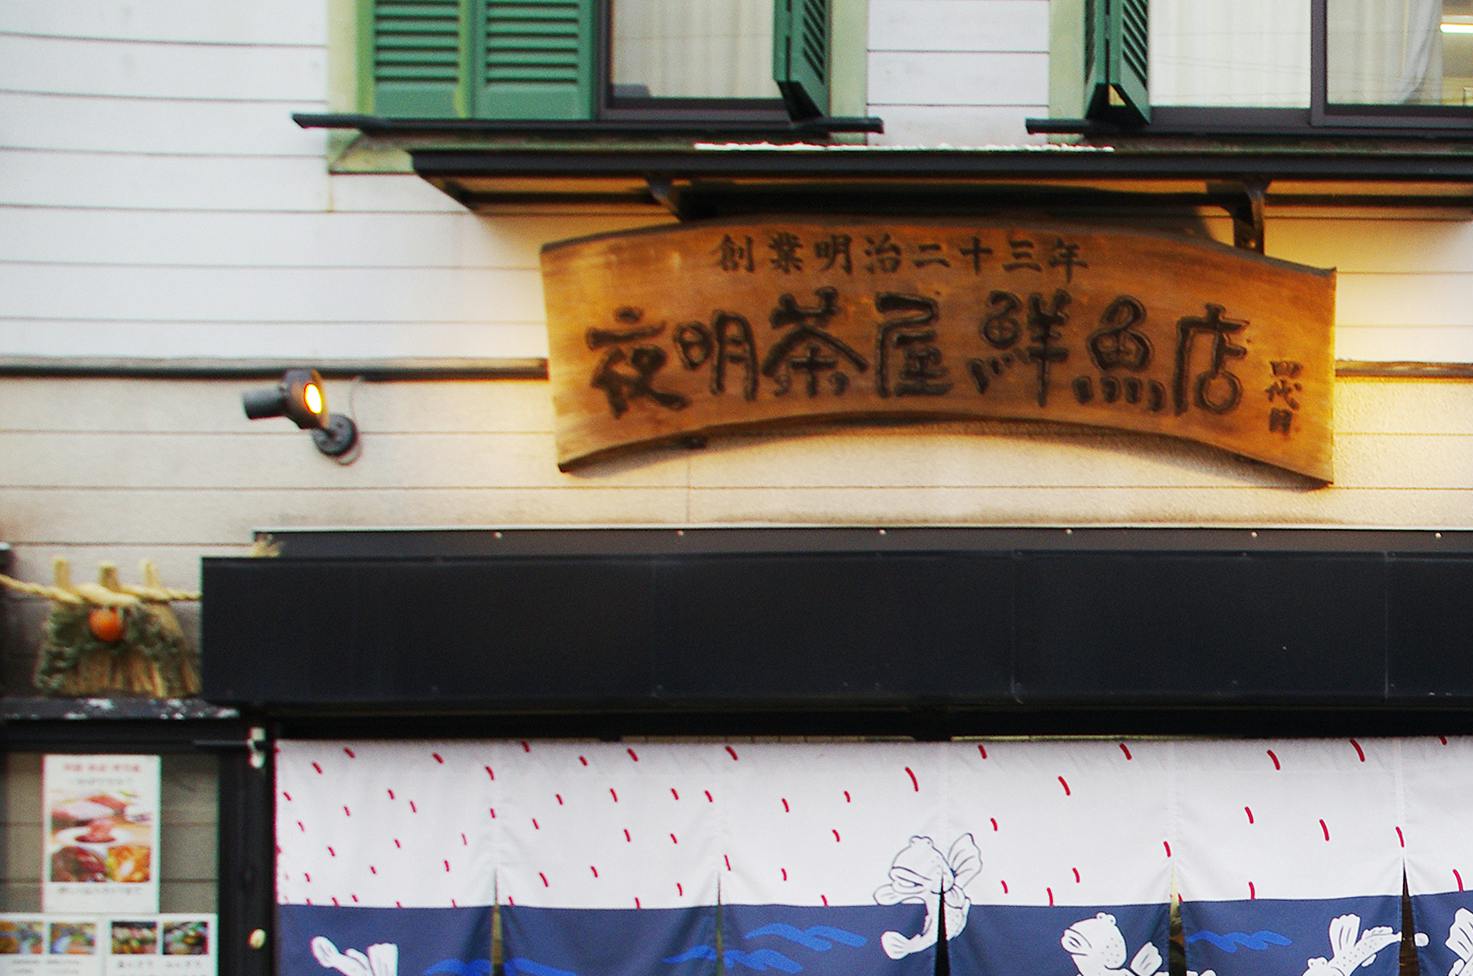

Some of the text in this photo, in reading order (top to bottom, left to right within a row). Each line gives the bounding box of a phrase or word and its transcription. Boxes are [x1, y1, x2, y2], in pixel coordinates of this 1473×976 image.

[716, 231, 1089, 283] 創業明治二十三年
